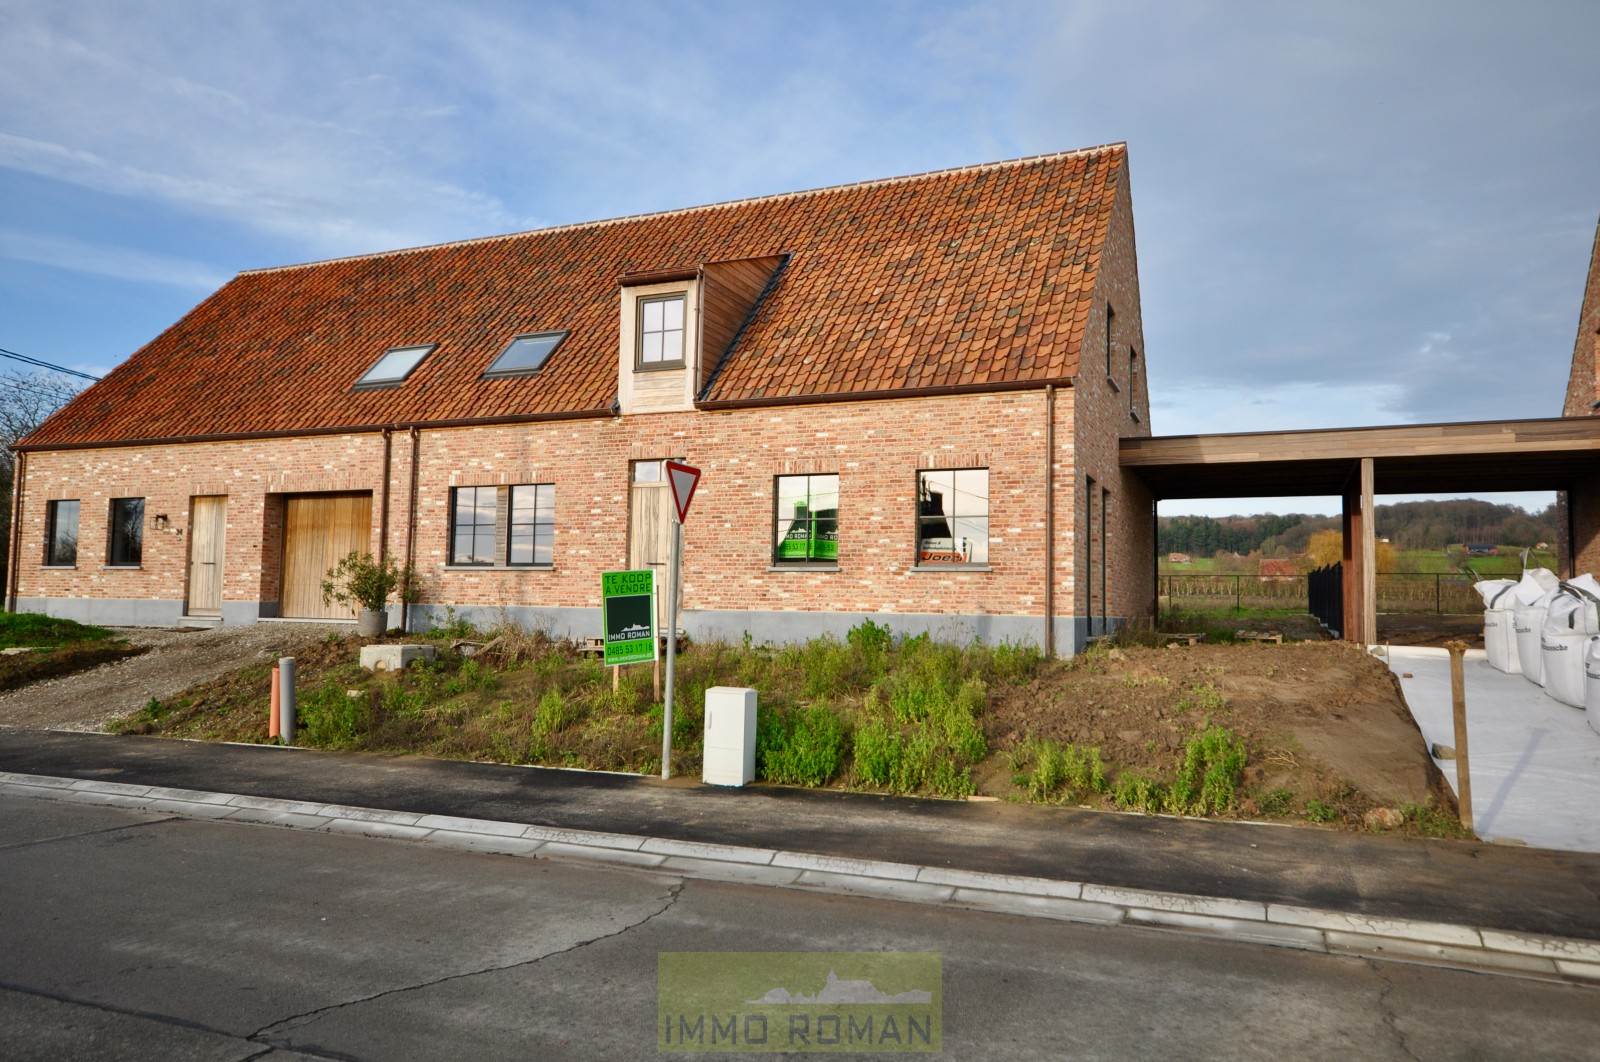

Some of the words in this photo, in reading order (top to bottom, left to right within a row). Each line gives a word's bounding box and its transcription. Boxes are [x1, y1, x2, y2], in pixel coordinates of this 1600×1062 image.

[605, 575, 618, 584] TE
[622, 573, 652, 583] KOOP
[605, 585, 612, 594] A
[614, 583, 651, 594] VENDRE
[608, 632, 626, 641] IMMO
[627, 630, 650, 639] ROMAN
[608, 645, 624, 656] 0485
[625, 644, 633, 654] 53
[635, 643, 643, 652] 17
[645, 642, 653, 651] 16
